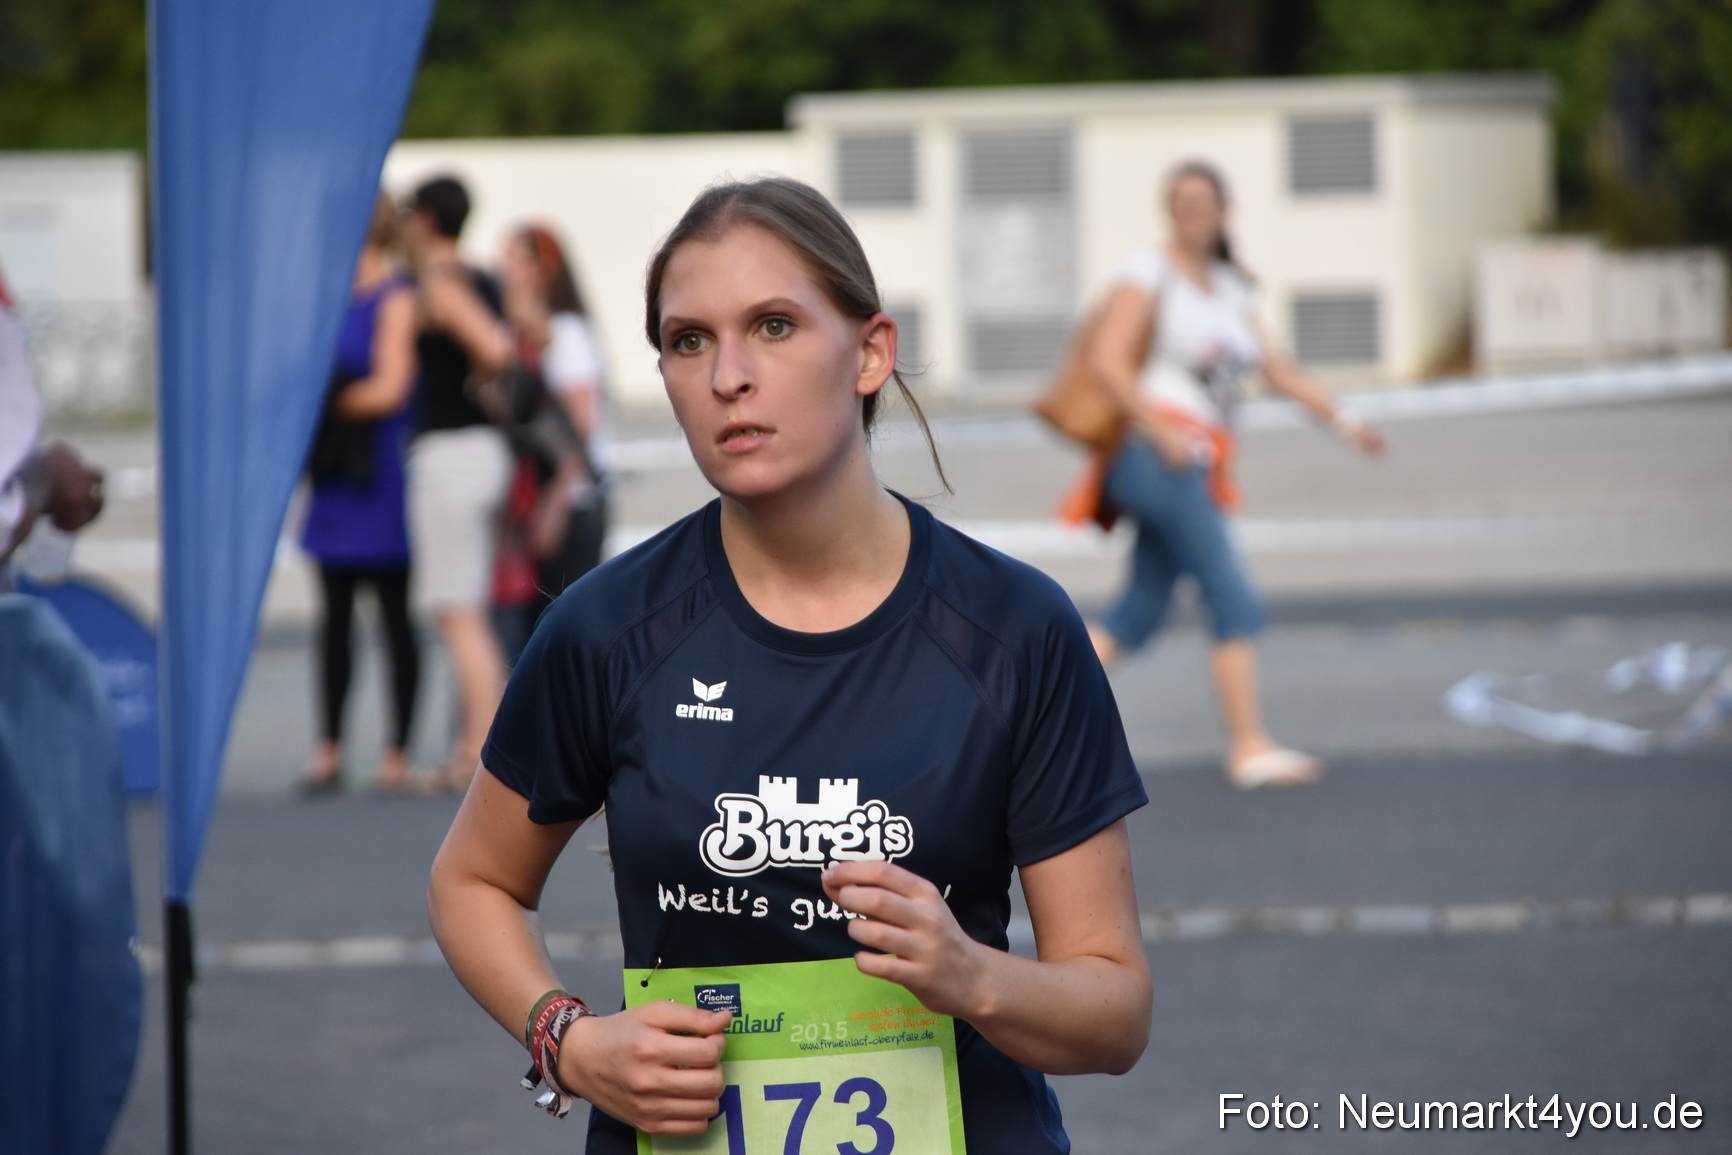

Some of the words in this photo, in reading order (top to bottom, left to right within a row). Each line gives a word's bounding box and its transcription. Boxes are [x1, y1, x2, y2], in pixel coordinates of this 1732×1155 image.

[675, 702, 734, 722] erima
[702, 796, 911, 874] Burgis
[657, 882, 769, 918] Weil's
[790, 897, 867, 931] gu
[704, 993, 734, 1001] Fischer
[790, 1020, 848, 1043] 2015
[799, 1029, 935, 1050] www.firmenlauf-oberpfalz.de
[708, 1077, 895, 1155] 173
